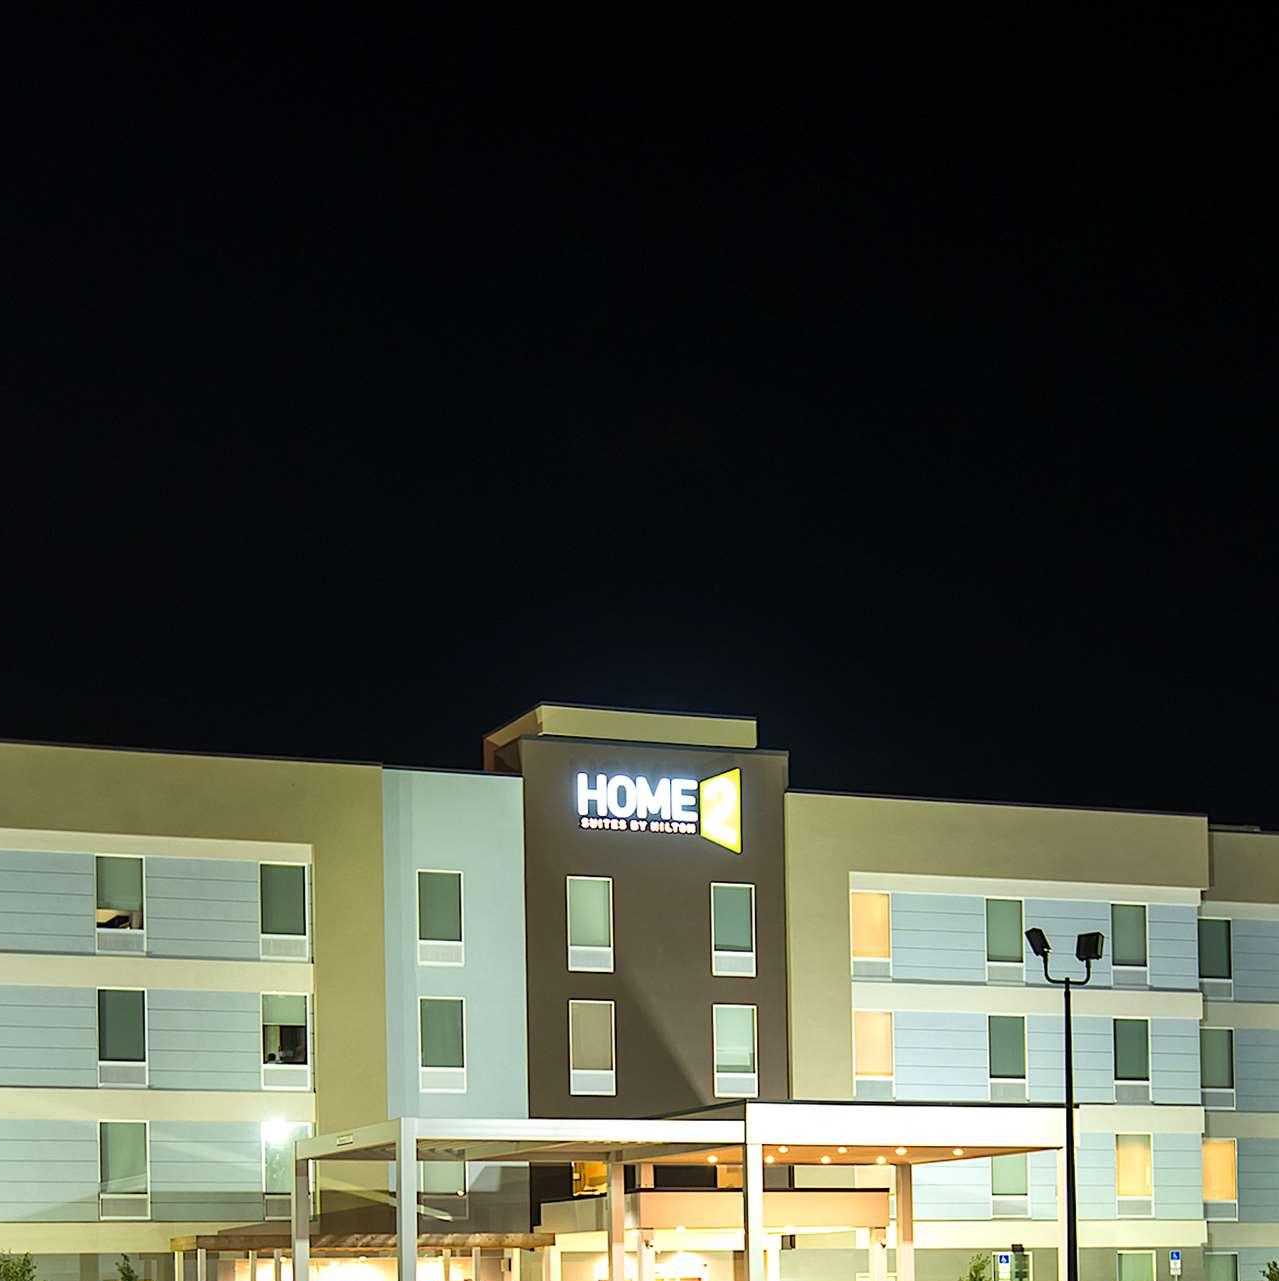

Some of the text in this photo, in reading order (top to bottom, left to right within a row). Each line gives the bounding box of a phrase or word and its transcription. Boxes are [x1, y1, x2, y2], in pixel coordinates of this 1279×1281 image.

[577, 772, 698, 821] HOME
[581, 817, 697, 835] SUITES BY HILTON
